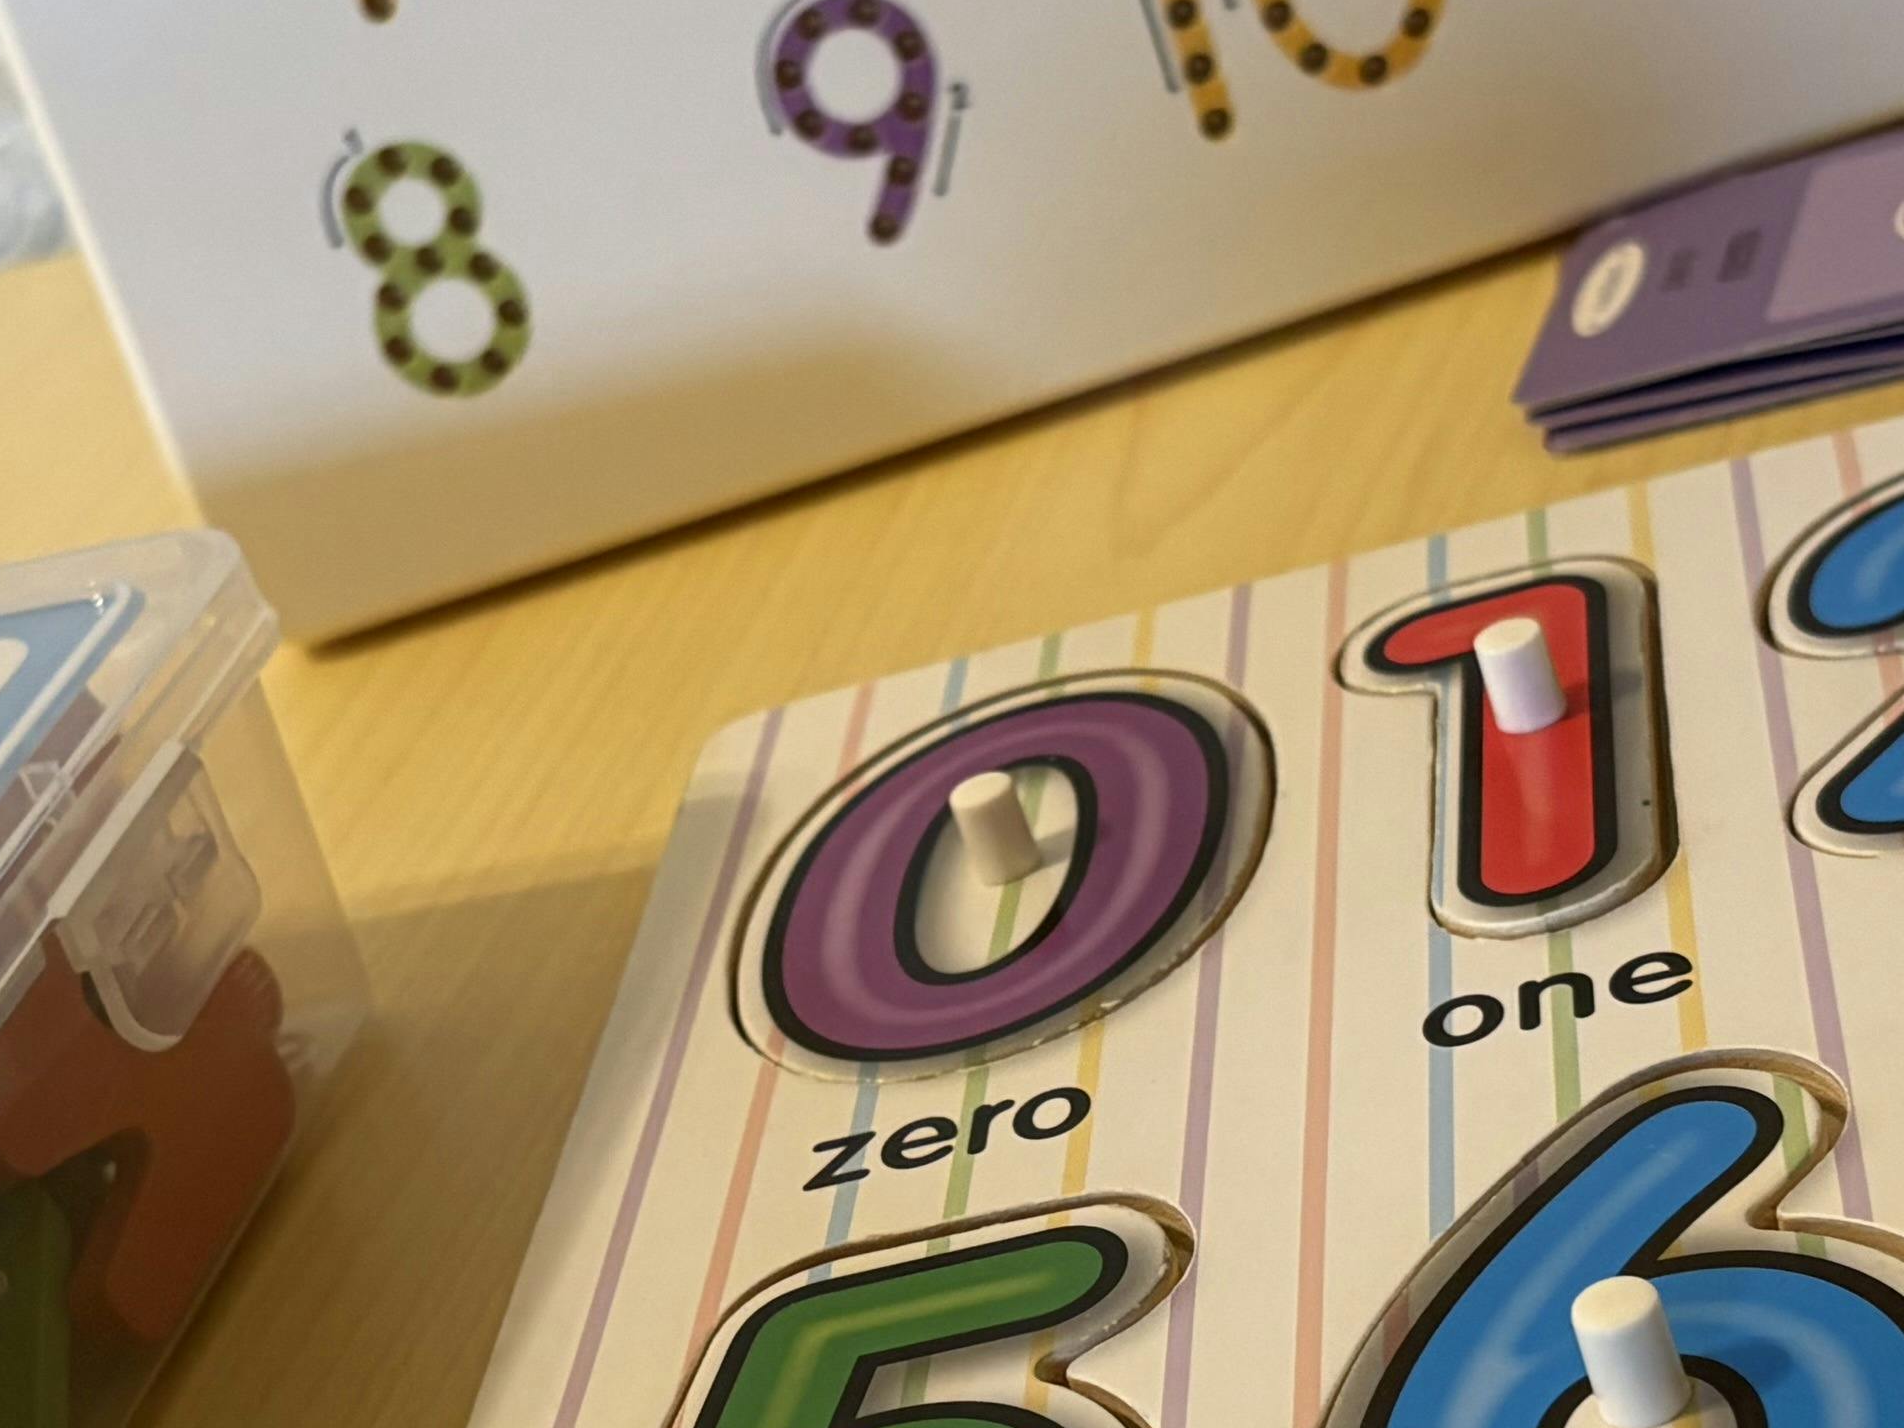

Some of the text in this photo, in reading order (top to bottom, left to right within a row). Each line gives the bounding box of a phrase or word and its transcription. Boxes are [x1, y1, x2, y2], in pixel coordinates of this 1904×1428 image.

[343, 142, 533, 399] 8
[1365, 572, 1618, 906] 1
[760, 689, 1232, 1063] 0
[1419, 945, 1696, 1050] one
[799, 1083, 1093, 1194] zero
